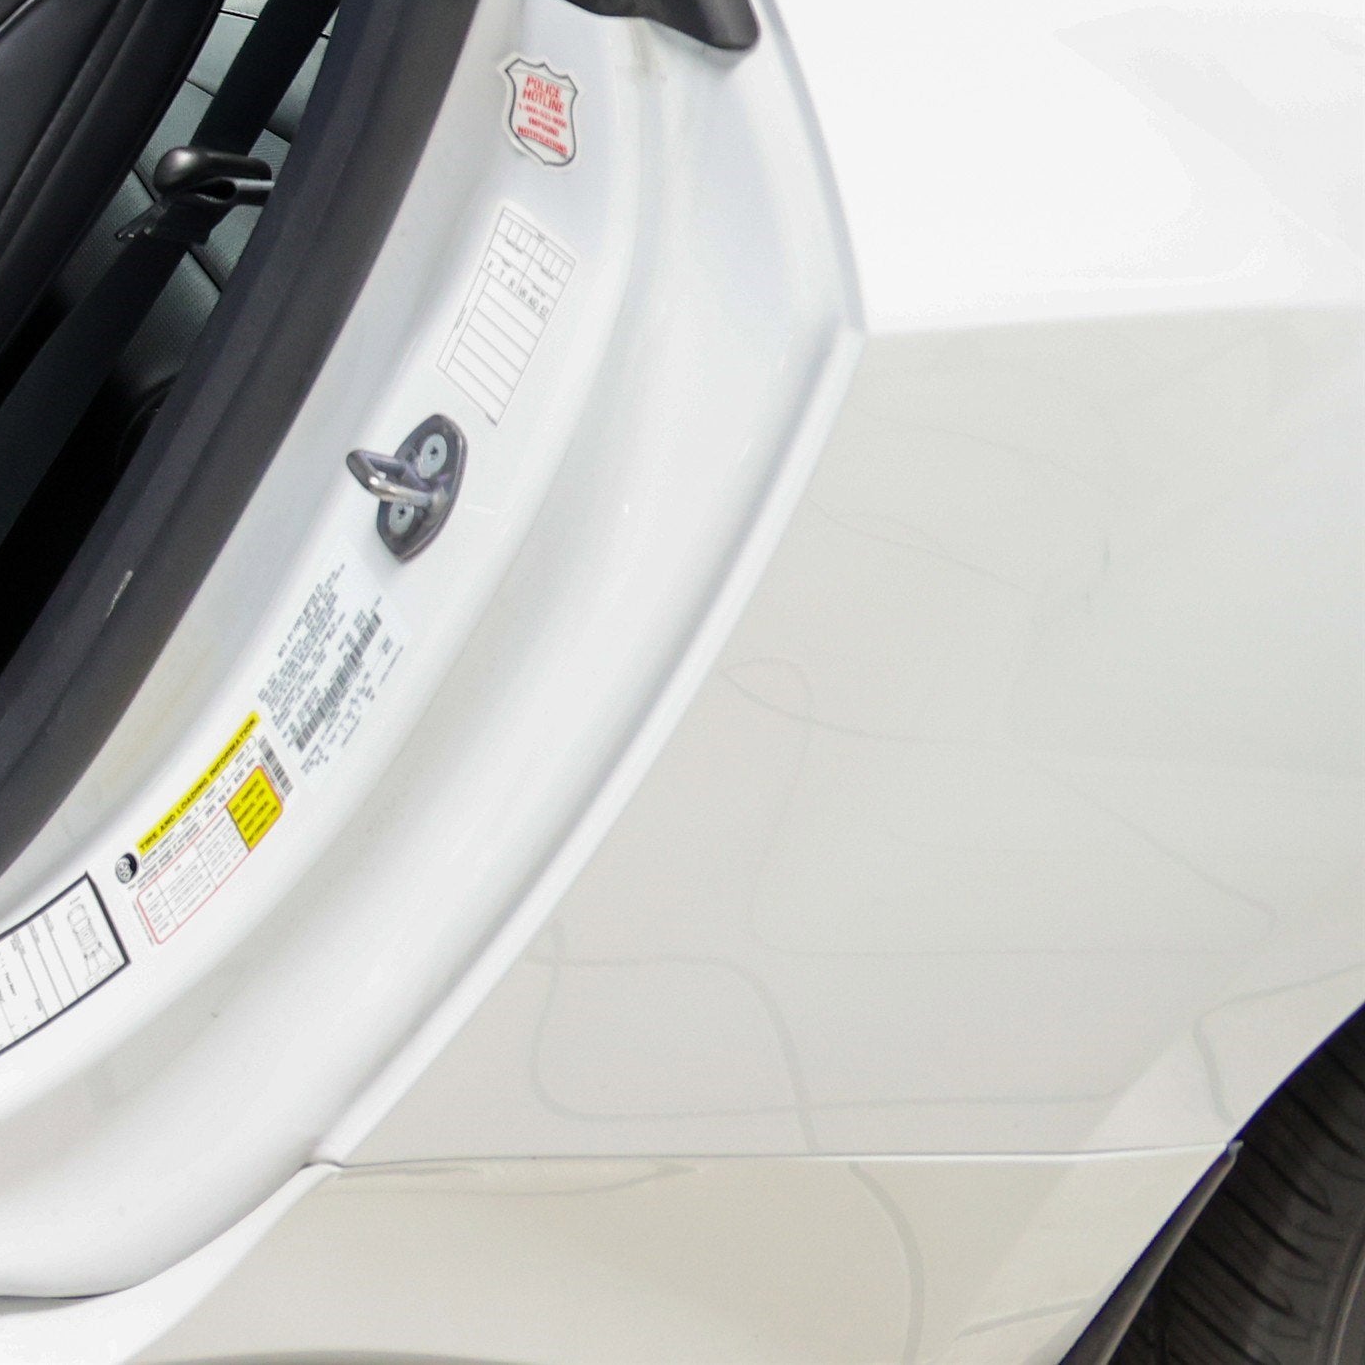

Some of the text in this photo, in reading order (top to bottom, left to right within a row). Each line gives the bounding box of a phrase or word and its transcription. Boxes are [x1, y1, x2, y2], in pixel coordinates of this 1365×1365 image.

[526, 74, 561, 99] POLICE
[522, 87, 565, 114] HOTLINE
[139, 717, 256, 851] TIRE AND LOADING INFORMATION
